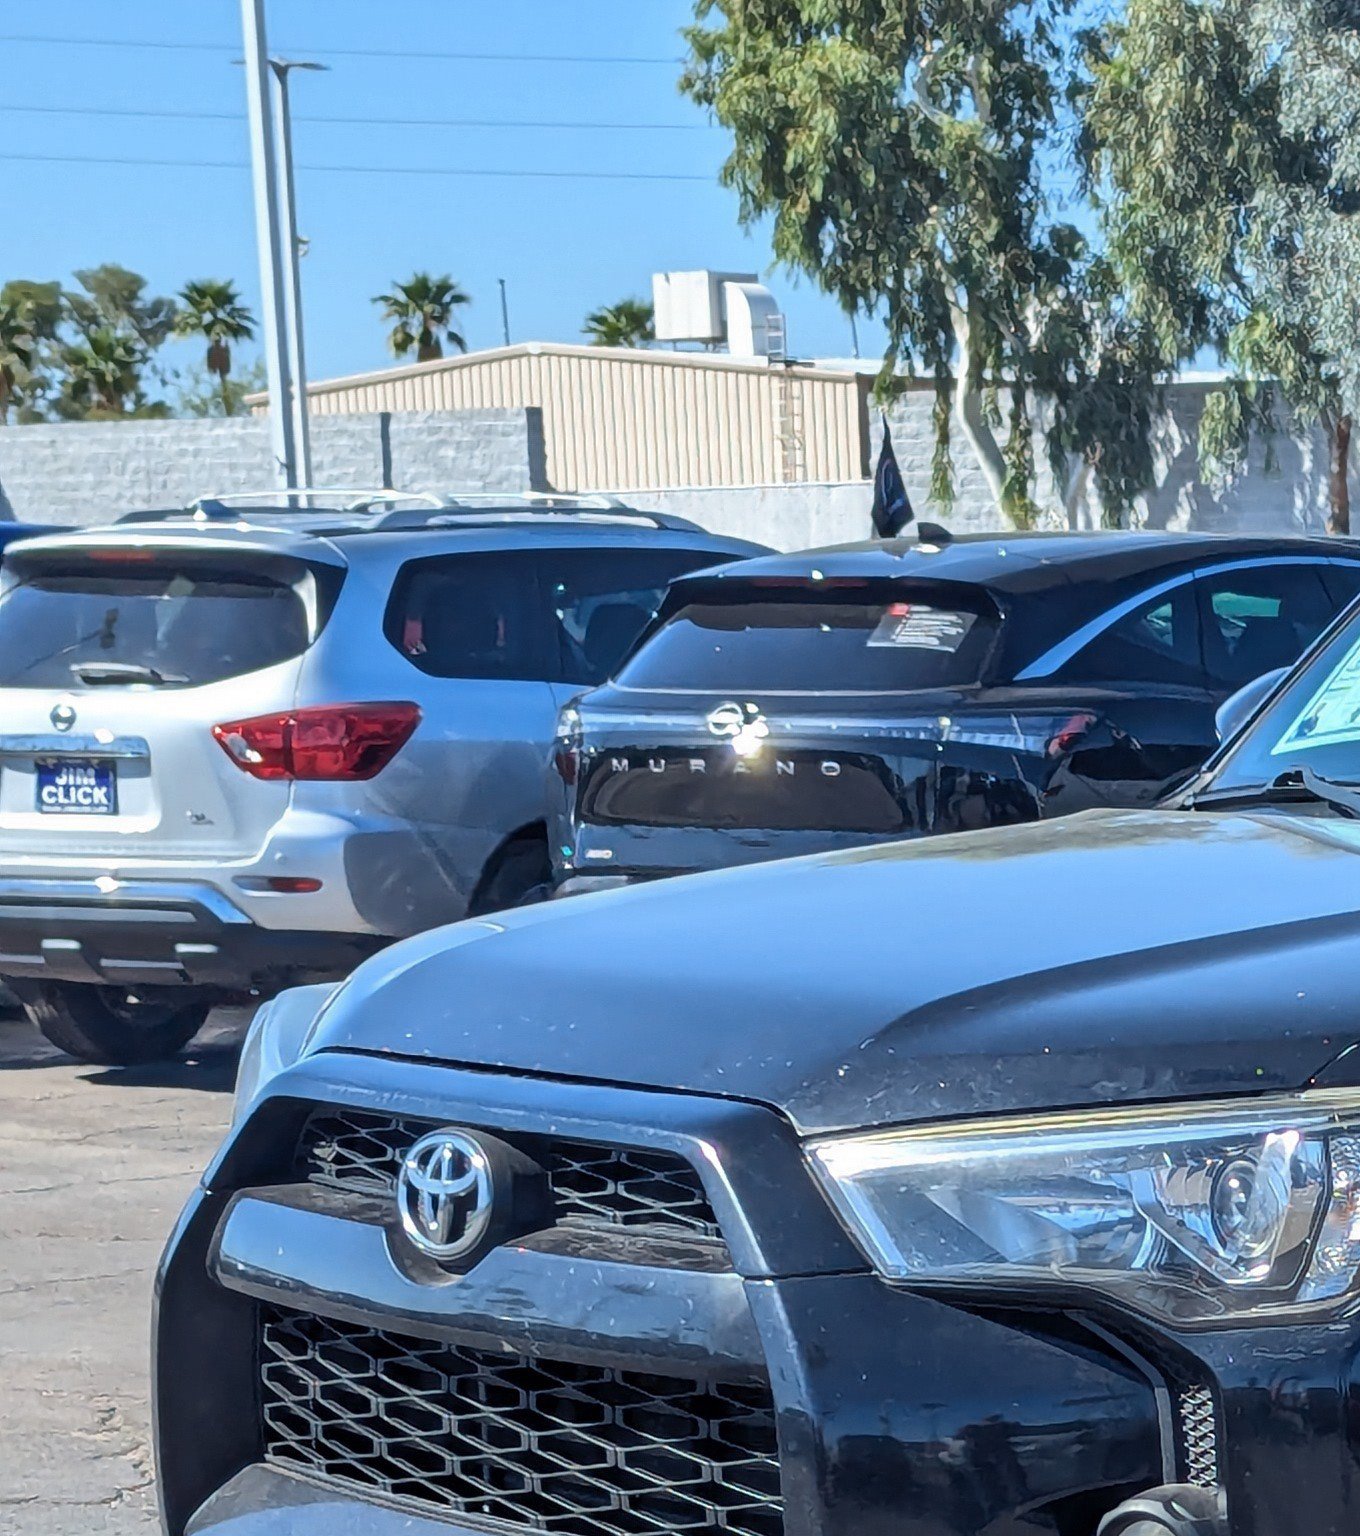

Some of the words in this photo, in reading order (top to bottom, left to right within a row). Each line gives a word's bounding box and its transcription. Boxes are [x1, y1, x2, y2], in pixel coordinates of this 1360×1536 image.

[55, 767, 96, 785] JIM
[611, 758, 842, 777] MURANO
[42, 785, 108, 805] CLICK
